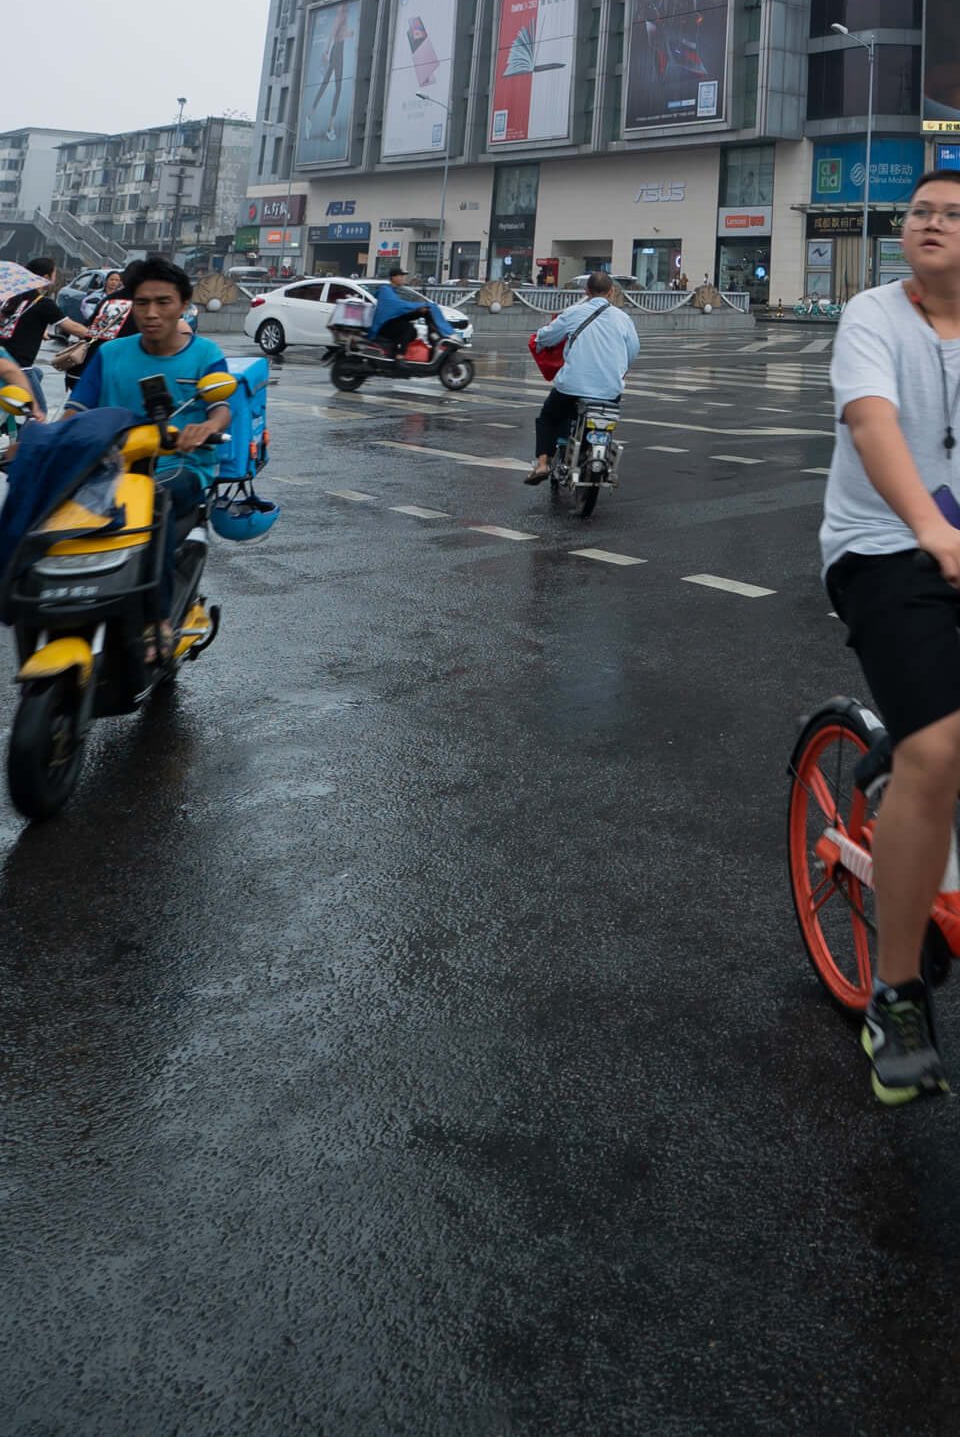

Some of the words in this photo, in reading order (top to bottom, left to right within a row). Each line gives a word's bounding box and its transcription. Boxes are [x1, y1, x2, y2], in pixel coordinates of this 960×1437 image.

[868, 163, 913, 176] 中国移动
[633, 178, 687, 204] ASUS
[326, 200, 356, 216] ASUS
